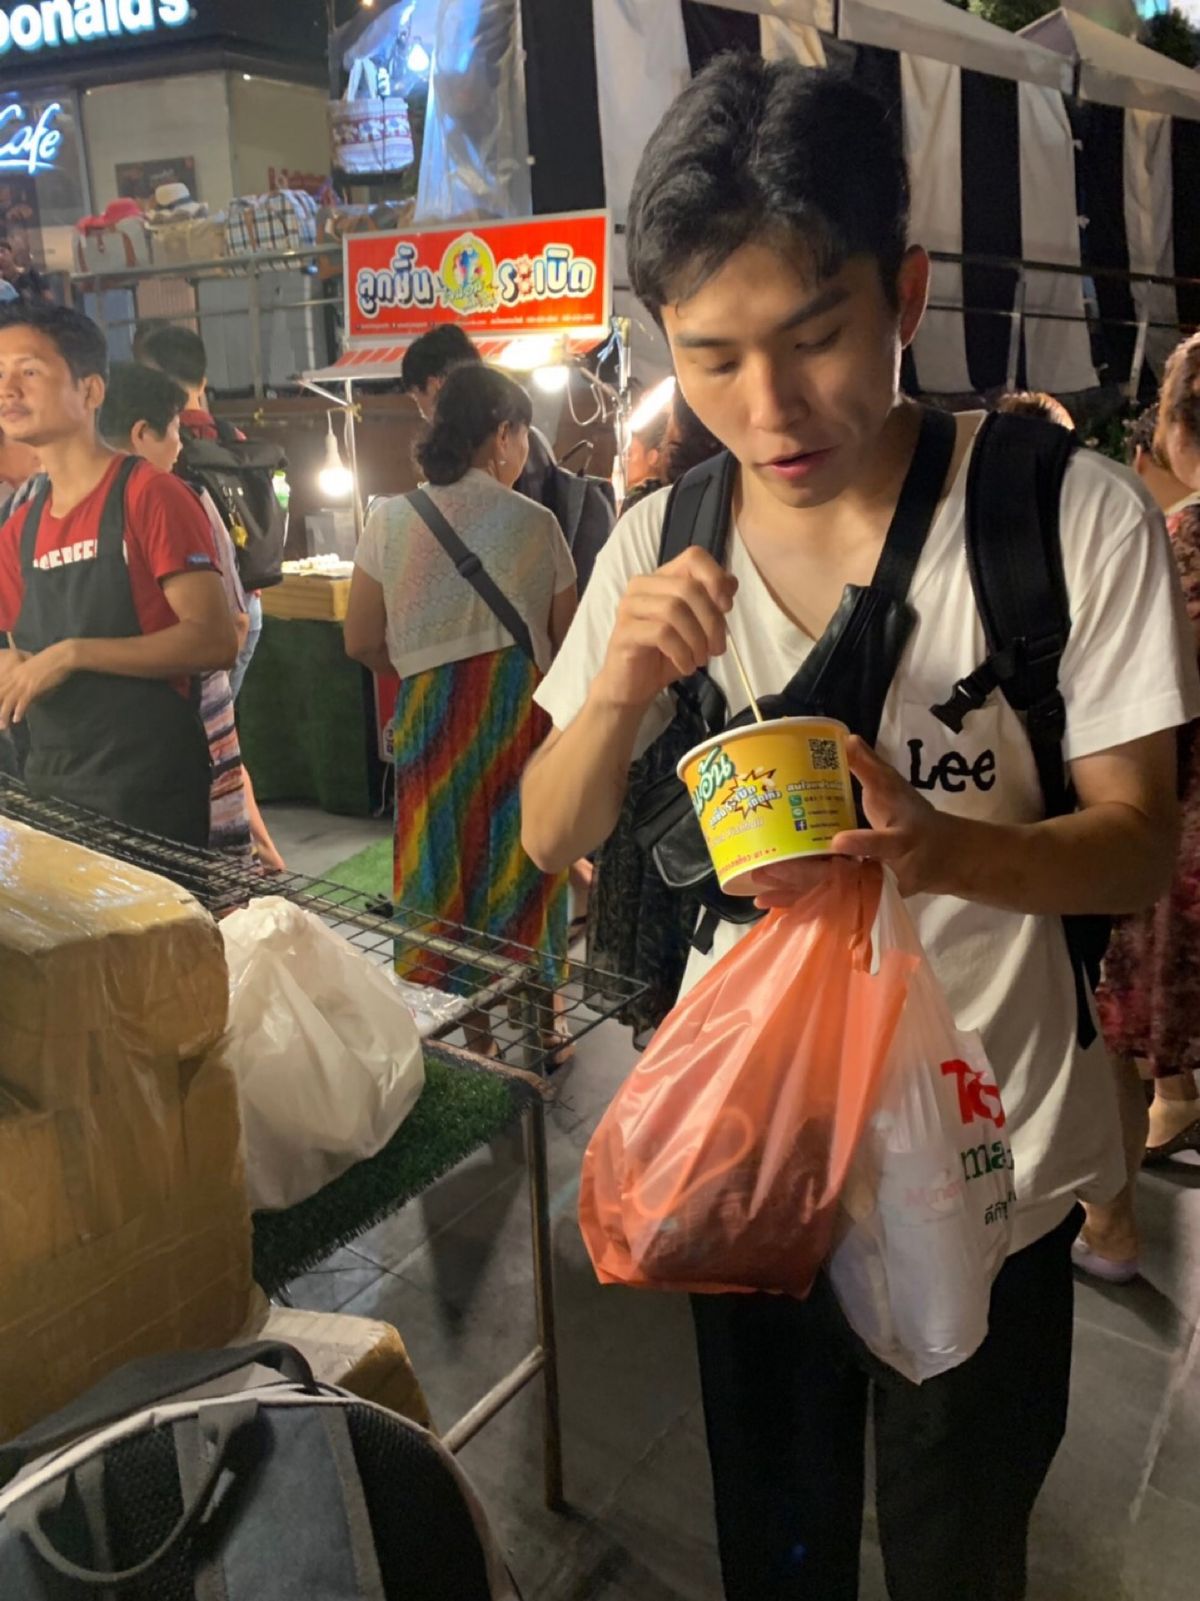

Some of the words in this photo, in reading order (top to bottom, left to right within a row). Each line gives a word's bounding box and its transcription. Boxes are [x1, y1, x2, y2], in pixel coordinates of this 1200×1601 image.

[357, 244, 437, 316] ลูกชิ้น
[499, 246, 597, 304] ระเบิด
[907, 738, 996, 792] Lee
